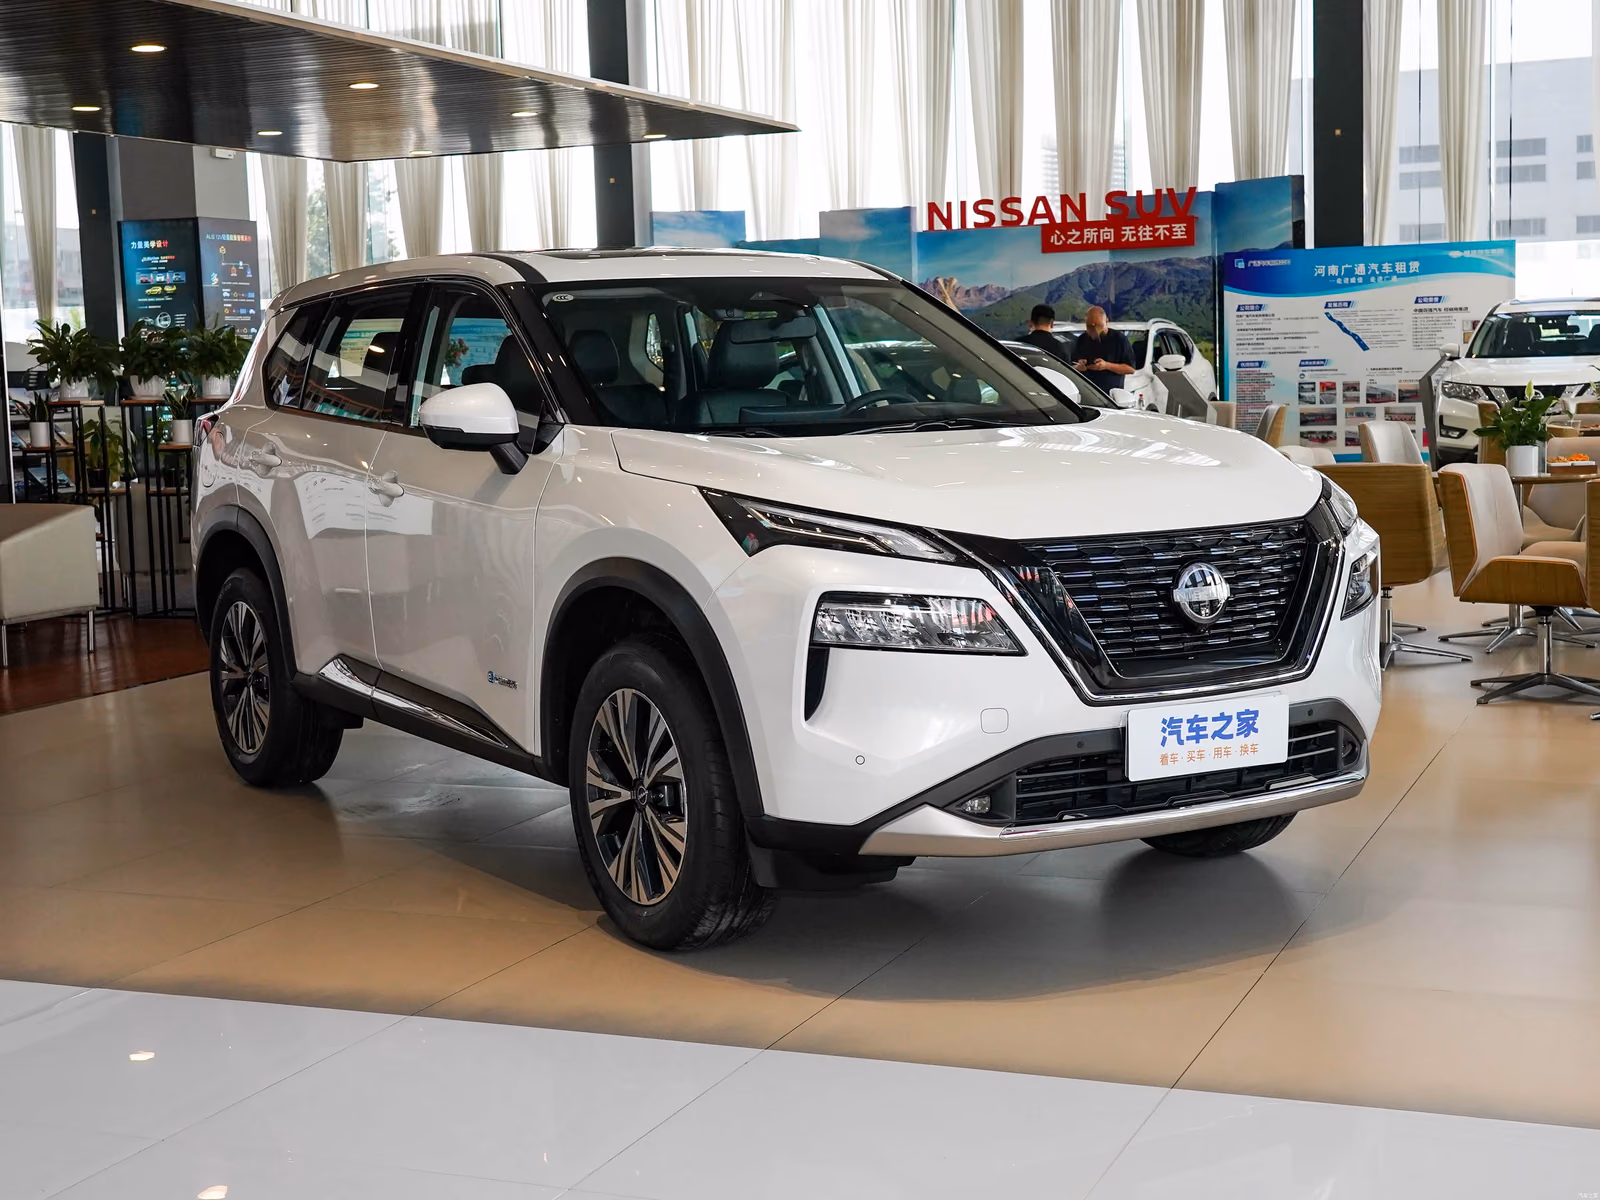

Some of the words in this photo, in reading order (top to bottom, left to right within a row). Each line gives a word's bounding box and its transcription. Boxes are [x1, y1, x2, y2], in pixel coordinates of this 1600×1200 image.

[927, 192, 1087, 230] NISSAN
[1105, 187, 1197, 220] SUV
[130, 240, 169, 250] 力量美学设计
[1050, 227, 1115, 246] 心之所向
[1121, 223, 1188, 243] 无往不至
[1314, 261, 1420, 277] 河南广通汽车租赁
[1160, 708, 1260, 747] 汽车之家
